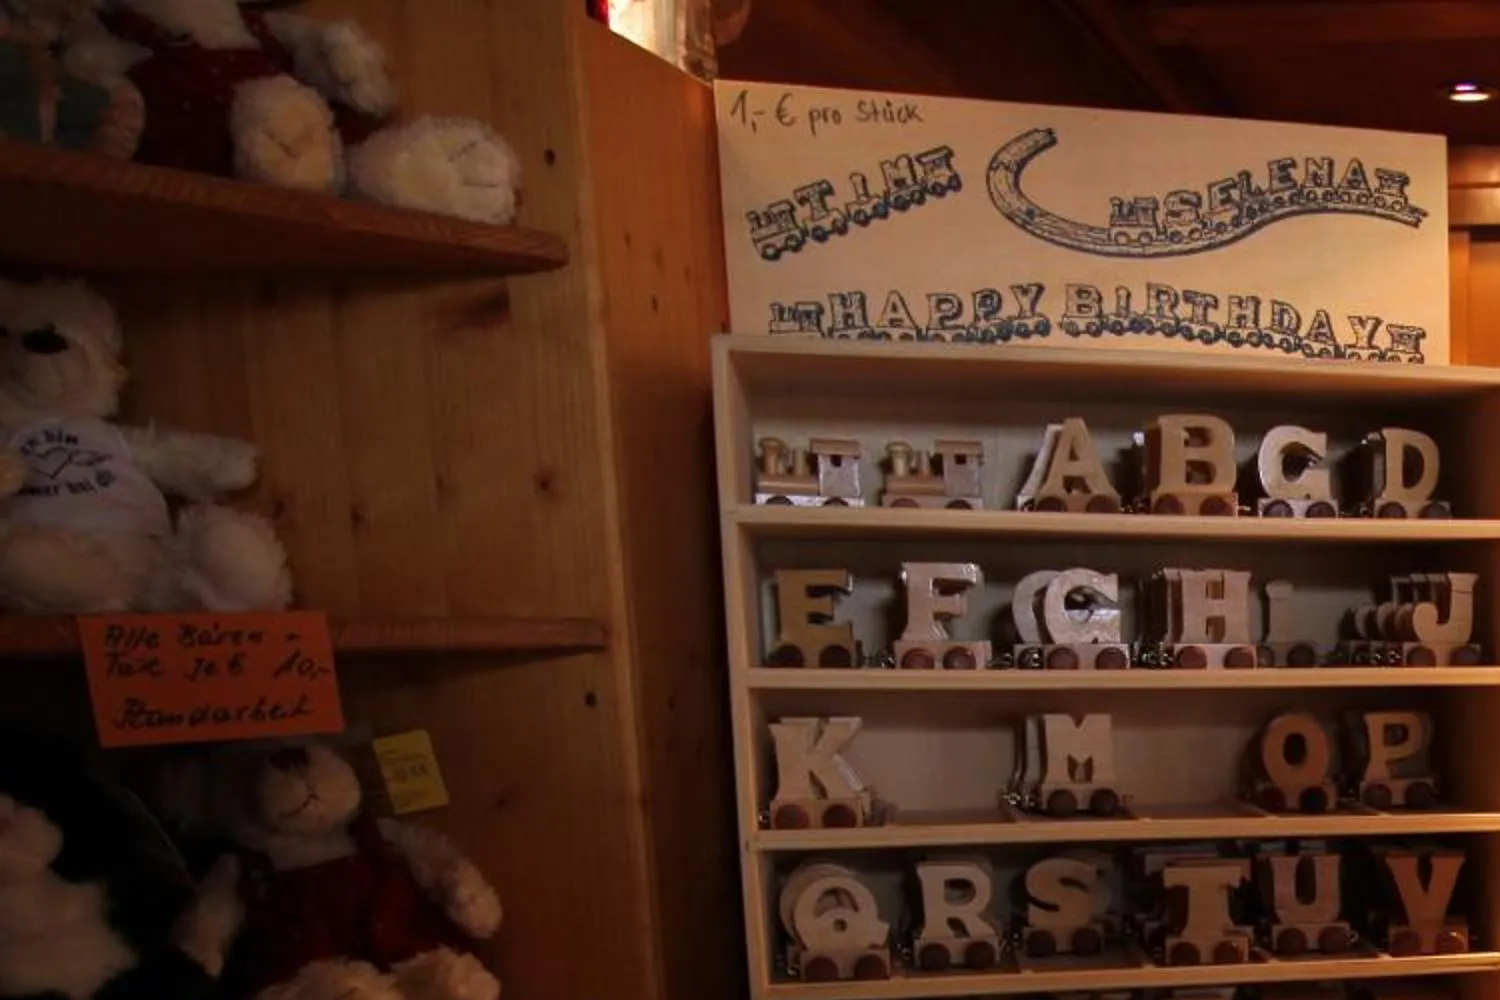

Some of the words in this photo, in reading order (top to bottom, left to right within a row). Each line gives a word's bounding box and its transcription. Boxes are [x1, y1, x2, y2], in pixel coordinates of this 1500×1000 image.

[775, 93, 797, 126] €
[808, 107, 843, 136] pro
[855, 99, 923, 124] Stück
[827, 282, 1046, 329] HAPPY
[1062, 281, 1384, 349] BIRTHDAY
